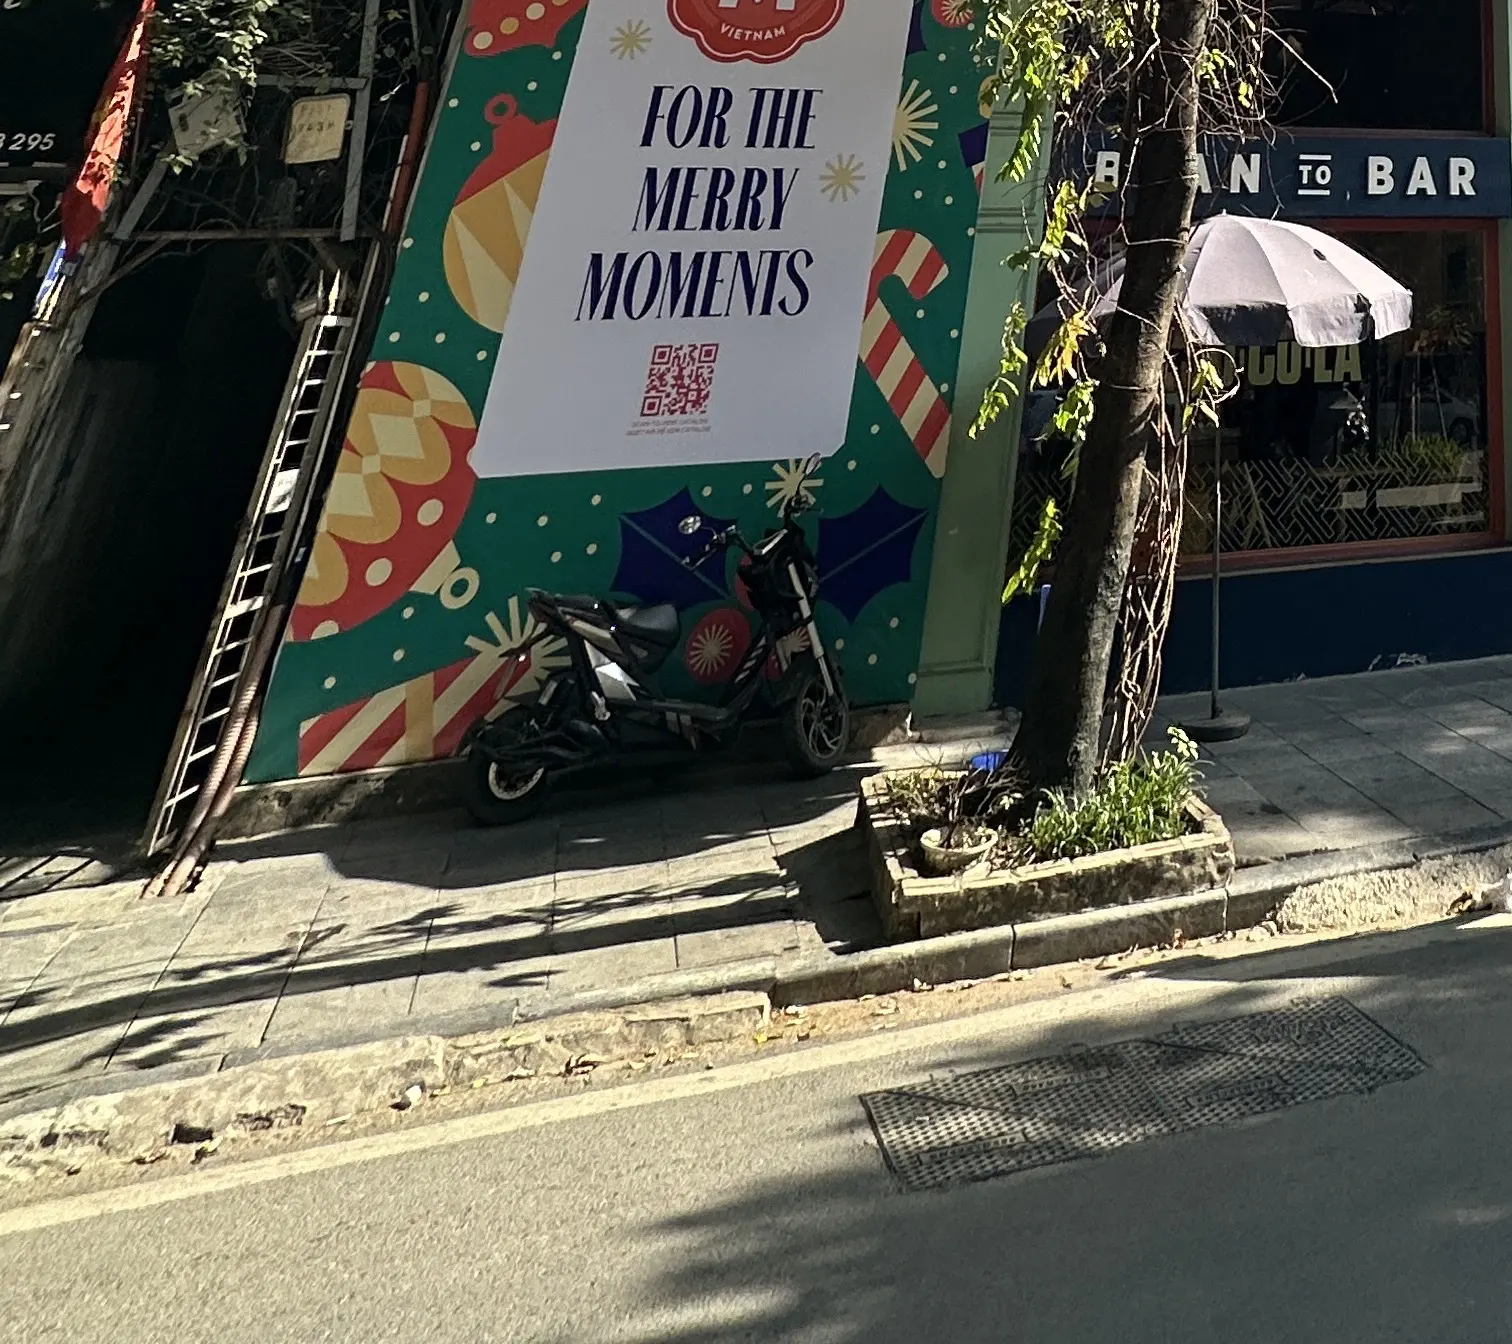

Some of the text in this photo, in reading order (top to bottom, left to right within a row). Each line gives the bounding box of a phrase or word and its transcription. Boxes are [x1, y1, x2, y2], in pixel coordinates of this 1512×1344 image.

[720, 23, 786, 41] VIETNAM
[639, 85, 823, 149] FOR THE
[632, 167, 799, 231] MERRY
[1095, 151, 1476, 196] BN TO BAR
[574, 249, 813, 322] MOMENTS
